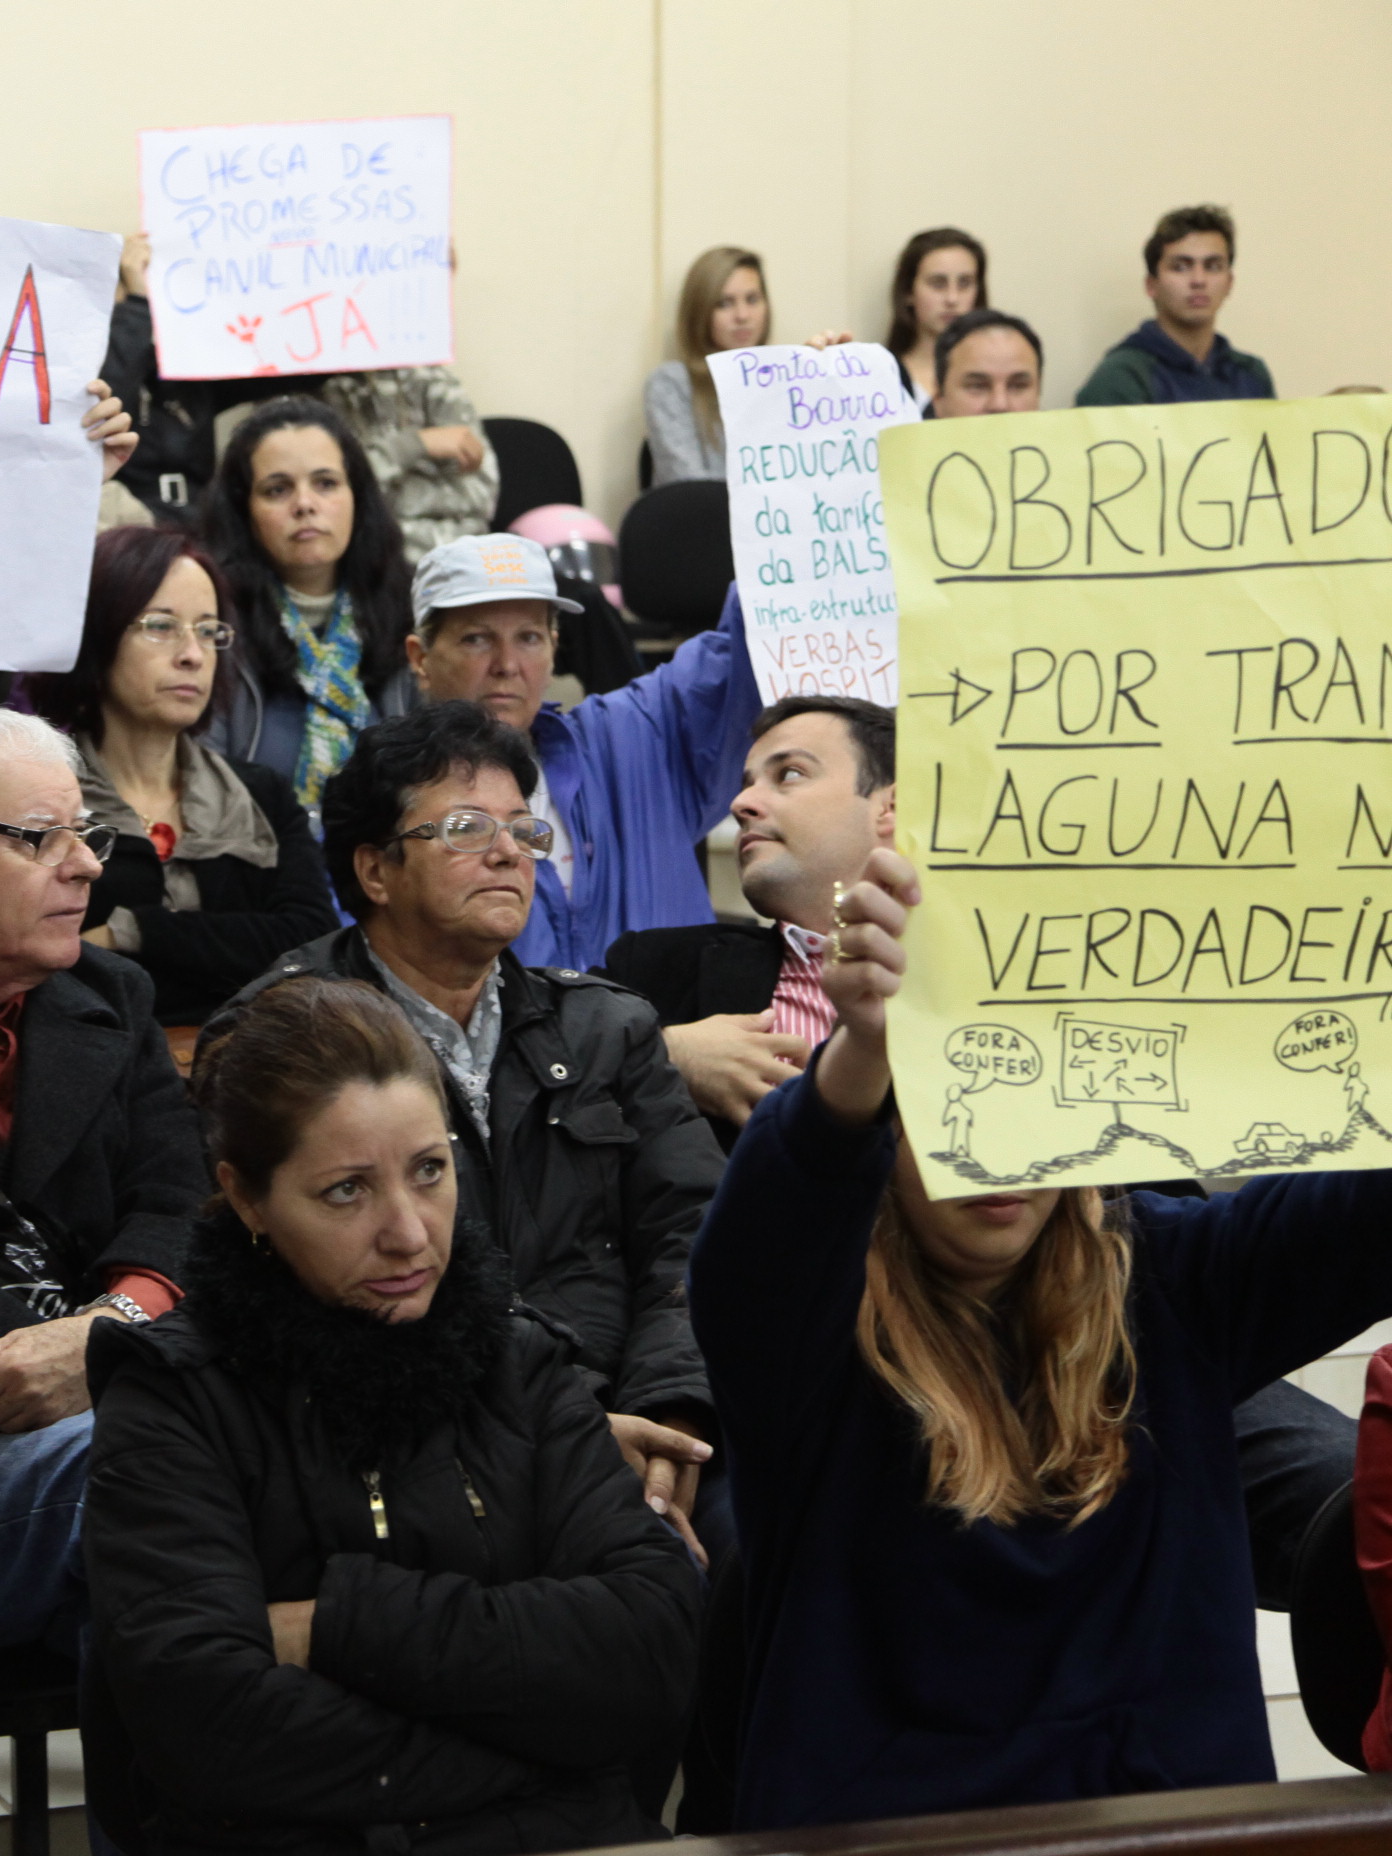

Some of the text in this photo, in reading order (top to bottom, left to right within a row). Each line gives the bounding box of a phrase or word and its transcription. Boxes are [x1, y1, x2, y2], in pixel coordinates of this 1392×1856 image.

[160, 141, 394, 206] CHEGA DE
[174, 184, 417, 249] PROMESSAS
[164, 248, 290, 314] CANIL
[733, 350, 871, 388] Ponta da
[738, 428, 879, 485] REDUÇÃO
[755, 496, 792, 537] da
[758, 536, 893, 586] da BALS
[754, 589, 897, 632] infra-estrutu
[763, 628, 884, 671] VERBAS
[1001, 636, 1392, 738] POR TRA
[929, 762, 1294, 859] LAGUNA
[964, 1029, 1022, 1053] FORA
[1071, 1027, 1170, 1058] DESVIO
[1294, 1013, 1341, 1035] FORA
